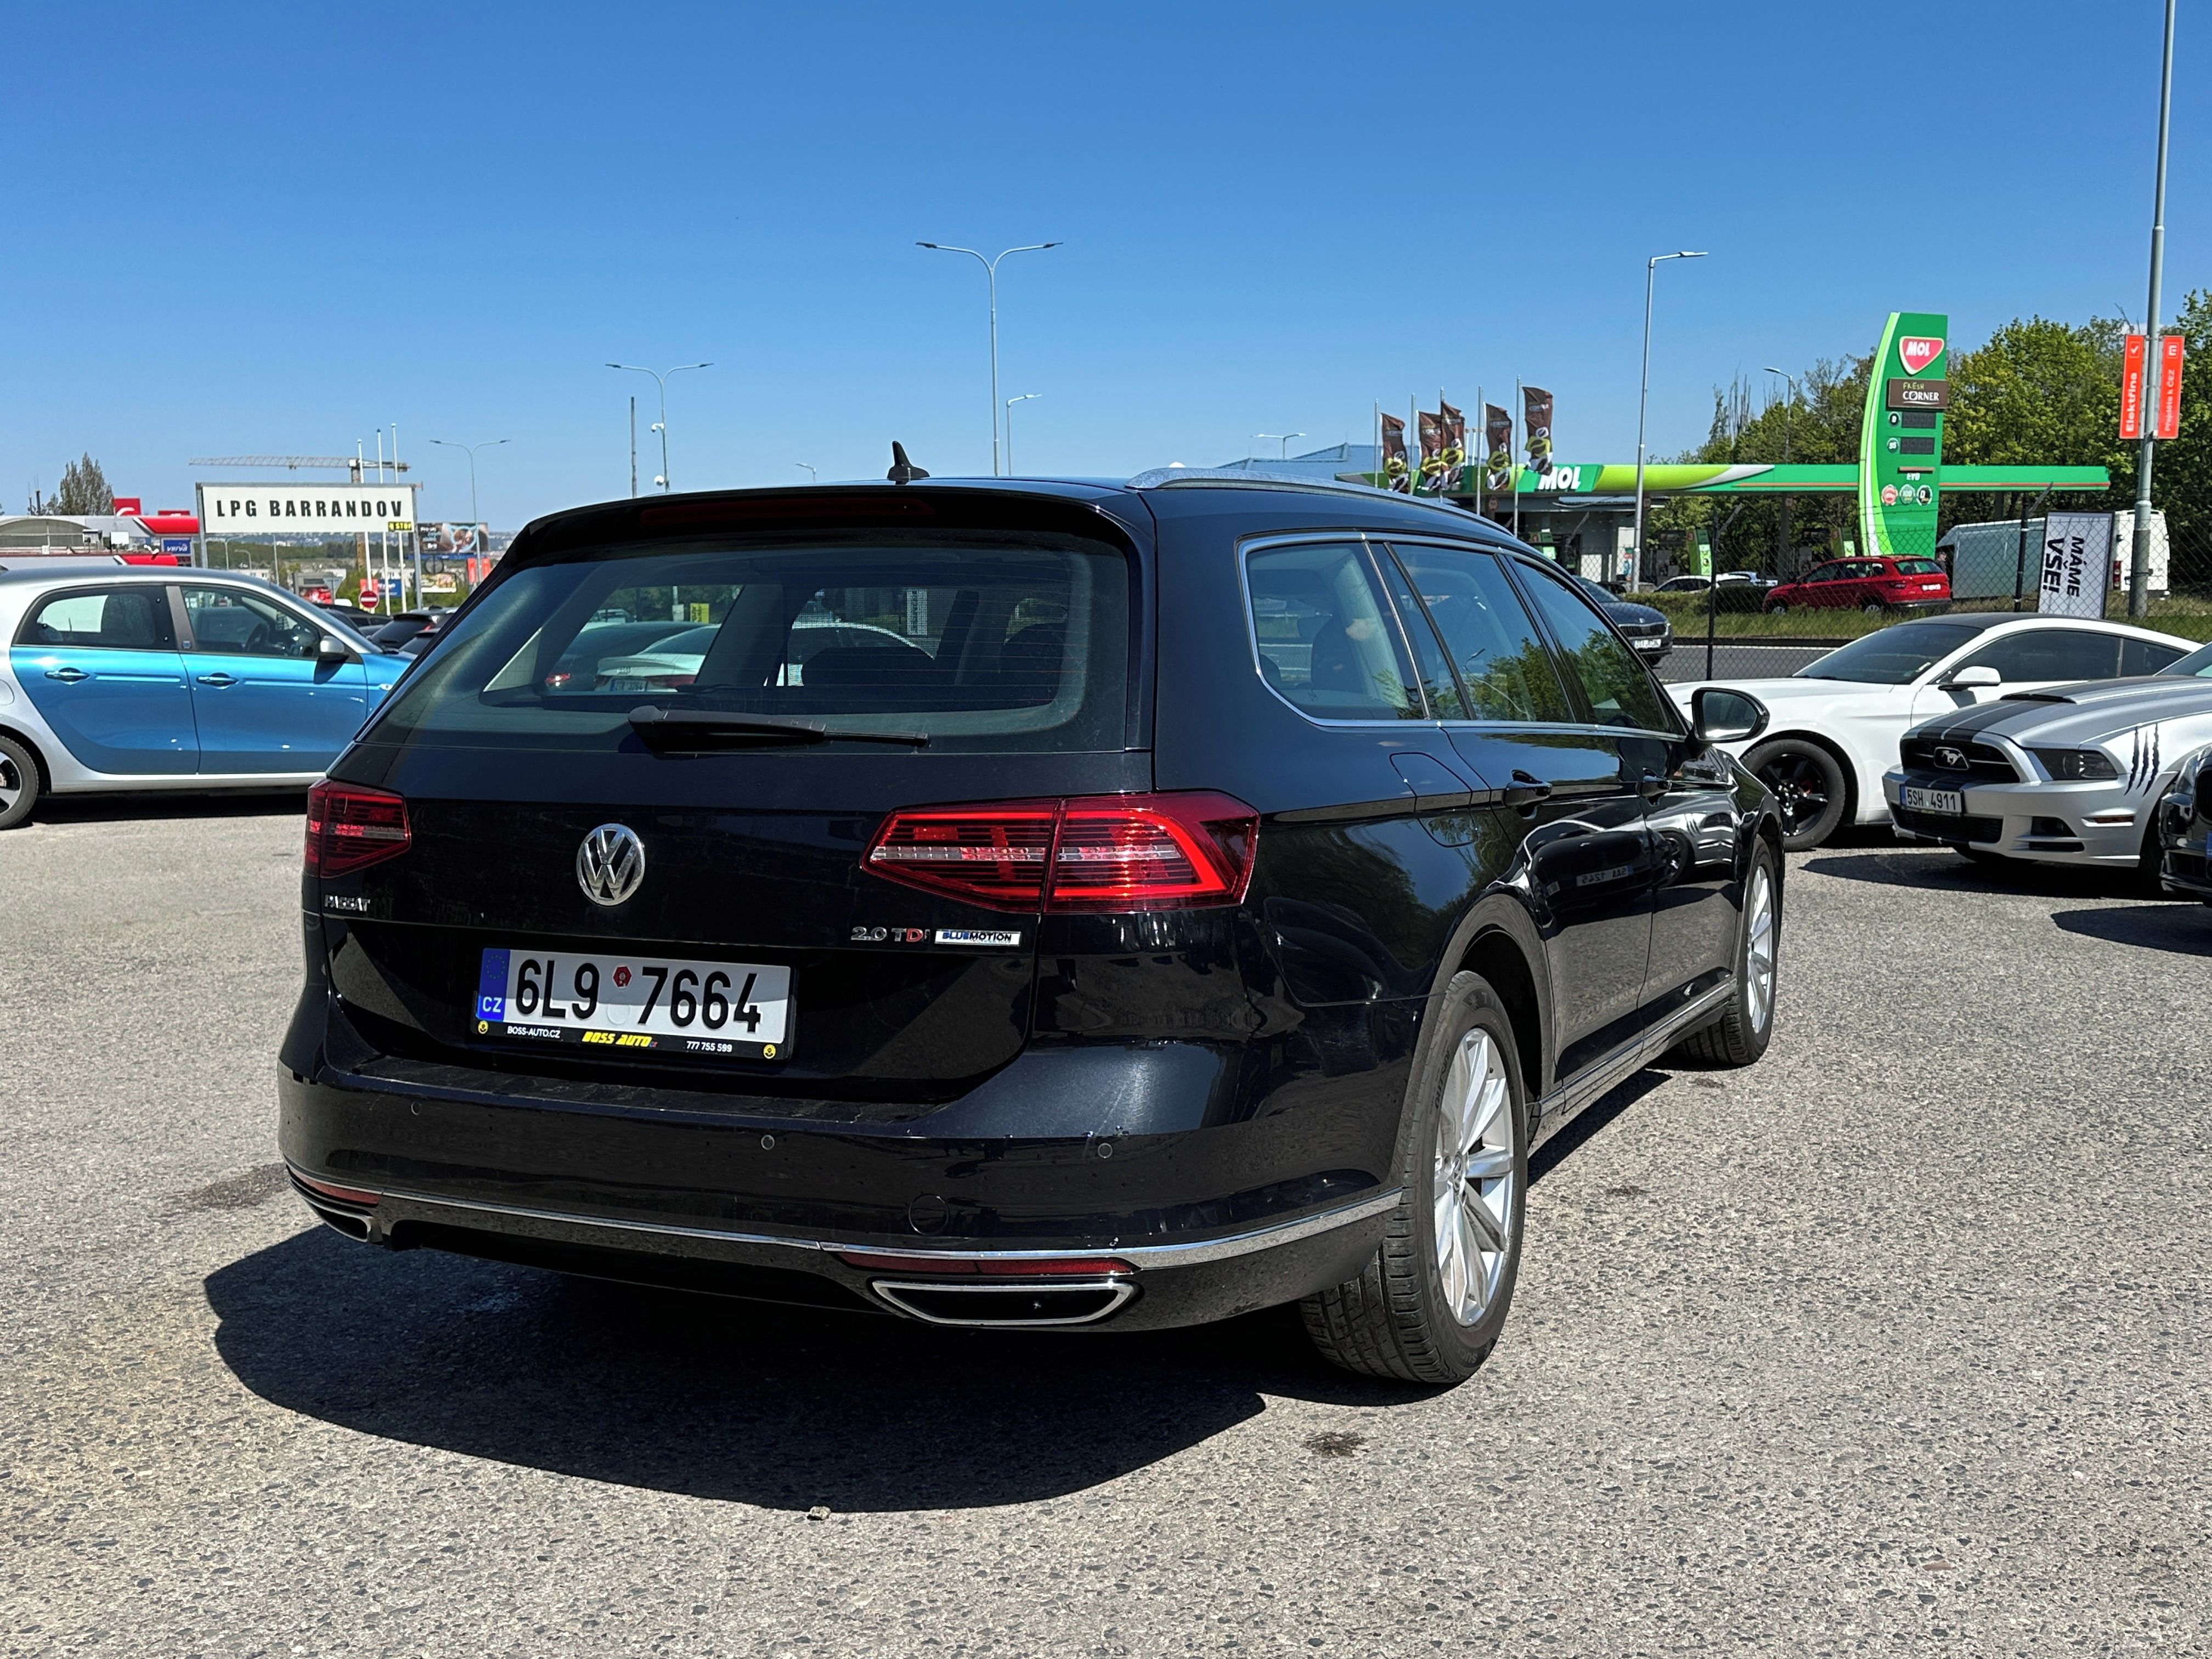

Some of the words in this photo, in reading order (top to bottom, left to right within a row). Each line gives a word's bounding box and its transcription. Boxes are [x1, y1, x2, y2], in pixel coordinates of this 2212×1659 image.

[1906, 341, 1930, 356] MOL
[1903, 391, 1939, 401] CORNER
[2125, 373, 2137, 432] Elektřina
[1538, 466, 1581, 490] MOL
[217, 500, 257, 517] LPG
[269, 500, 402, 517] BARRANDOV
[2043, 538, 2068, 593] VŠE!
[2067, 536, 2087, 597] MÁME
[1907, 789, 1924, 806] 5SH
[1931, 792, 1956, 811] 4911
[850, 926, 887, 941] 2.0
[891, 928, 930, 943] TDI
[943, 930, 1012, 941] BLUEMOTION
[482, 996, 501, 1013] CZ
[515, 958, 600, 1020] 6L9
[637, 966, 762, 1034] 7664
[507, 1026, 561, 1039] BOSS-AUTO.CZ
[582, 1031, 616, 1044] BOSS
[616, 1034, 652, 1047] AUTO
[686, 1041, 701, 1050] 777
[701, 1042, 715, 1052] 755
[717, 1043, 732, 1053] 599
